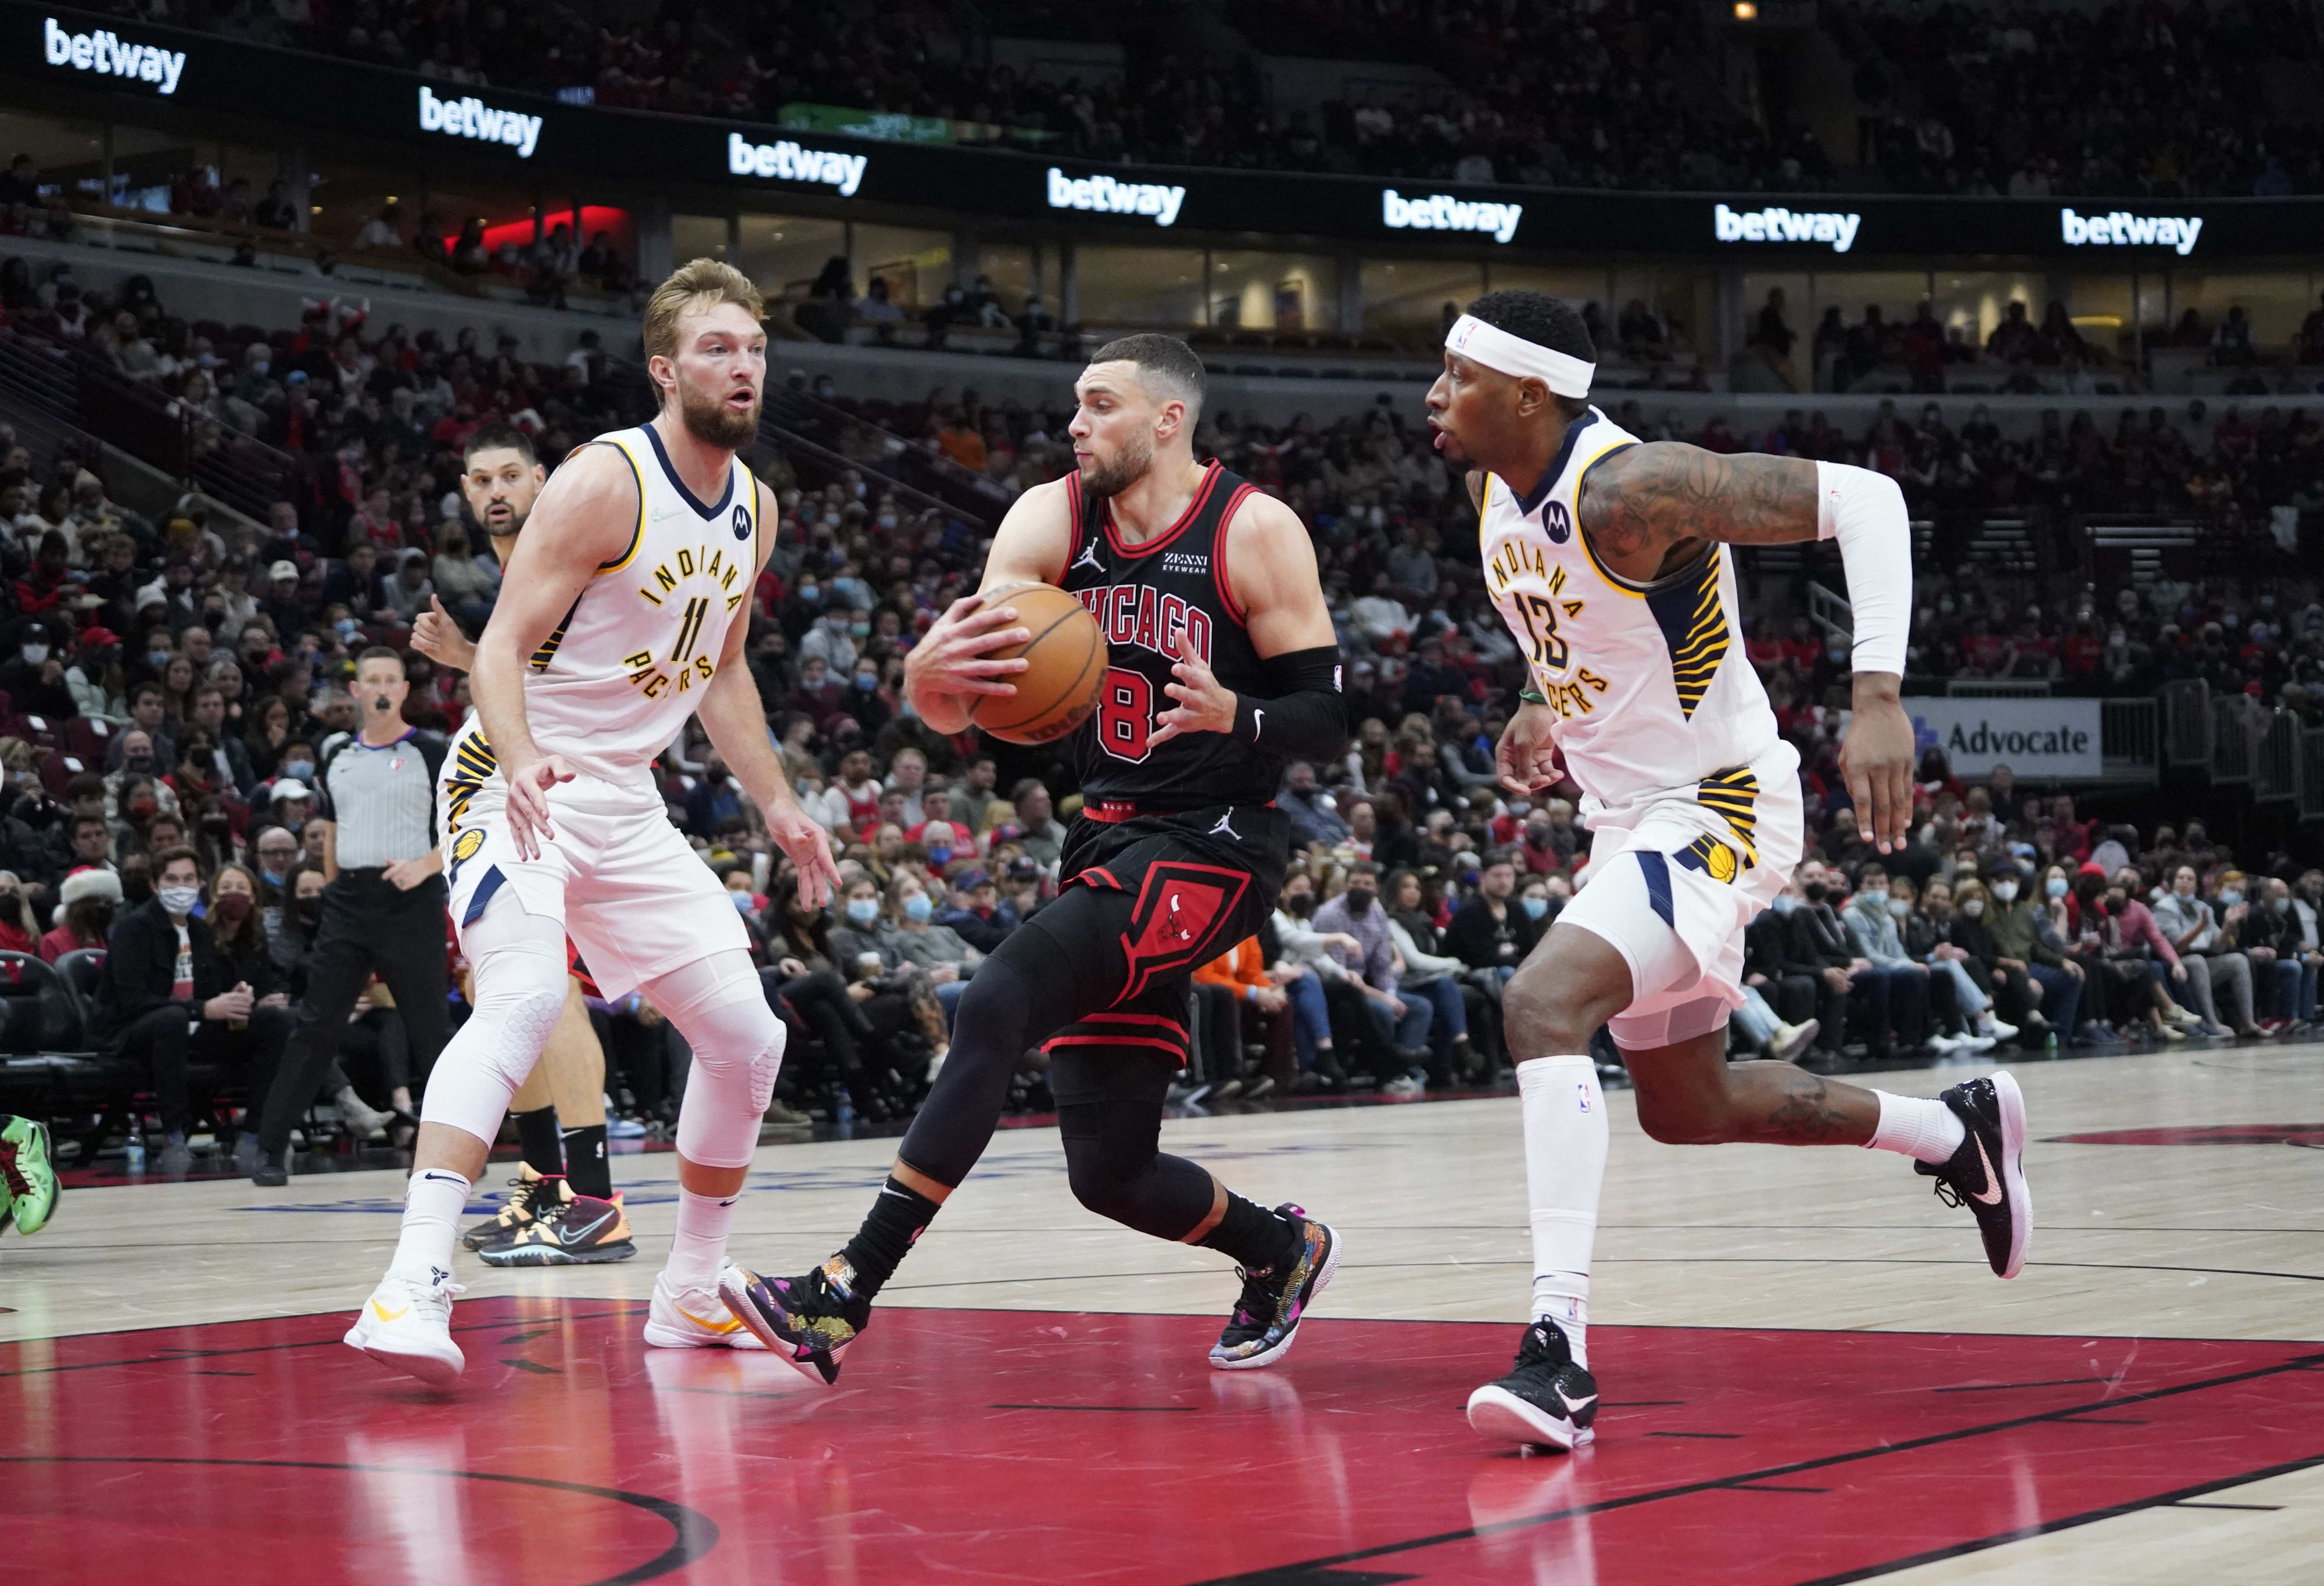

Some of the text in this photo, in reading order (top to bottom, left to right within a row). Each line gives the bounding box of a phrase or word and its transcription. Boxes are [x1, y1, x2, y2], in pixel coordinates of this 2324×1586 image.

[45, 17, 185, 94] betway
[419, 86, 542, 157] betway
[729, 133, 867, 196] betway
[1048, 167, 1186, 226] betway
[1383, 189, 1522, 243] betway
[1715, 204, 1861, 252] betway
[2062, 208, 2203, 255] betway
[639, 545, 744, 614] INDIANA
[1163, 564, 1207, 574] EYEWEAR
[1164, 553, 1208, 566] ZENNI
[671, 596, 709, 663] 11
[1513, 592, 1570, 672] 13
[623, 648, 715, 700] PACRS
[1098, 665, 1153, 764] 8
[1949, 720, 2089, 756] Advocate
